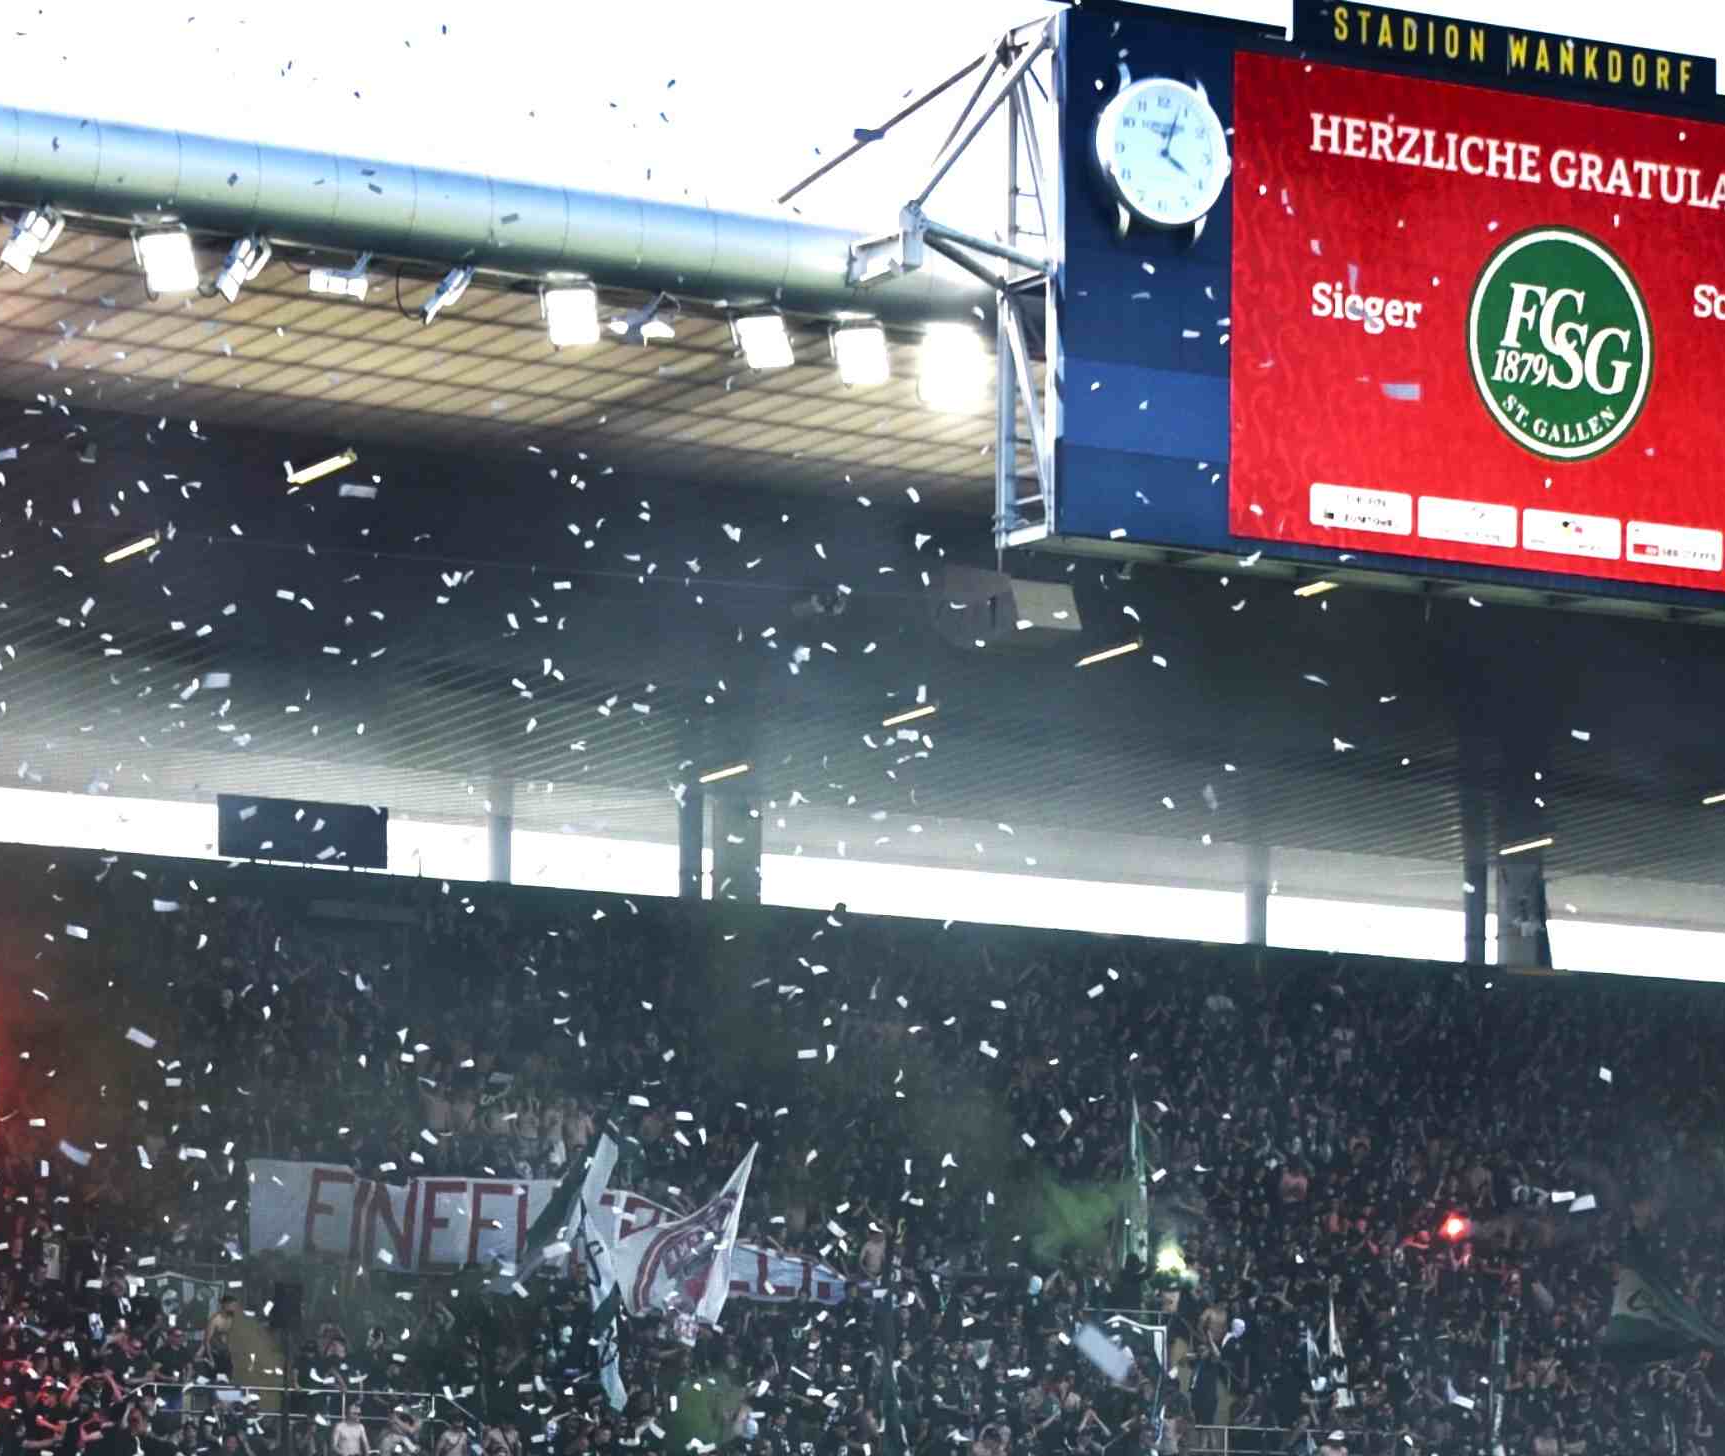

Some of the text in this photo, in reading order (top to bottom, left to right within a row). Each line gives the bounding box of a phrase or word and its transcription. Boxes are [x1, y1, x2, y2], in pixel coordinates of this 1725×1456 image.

[1333, 8, 1694, 94] STADION WANKDORF
[1309, 112, 1540, 186] HERZLICHE
[1311, 283, 1422, 334] Sieger
[1491, 349, 1549, 386] 1879
[1502, 394, 1617, 443] ST. GALLEN
